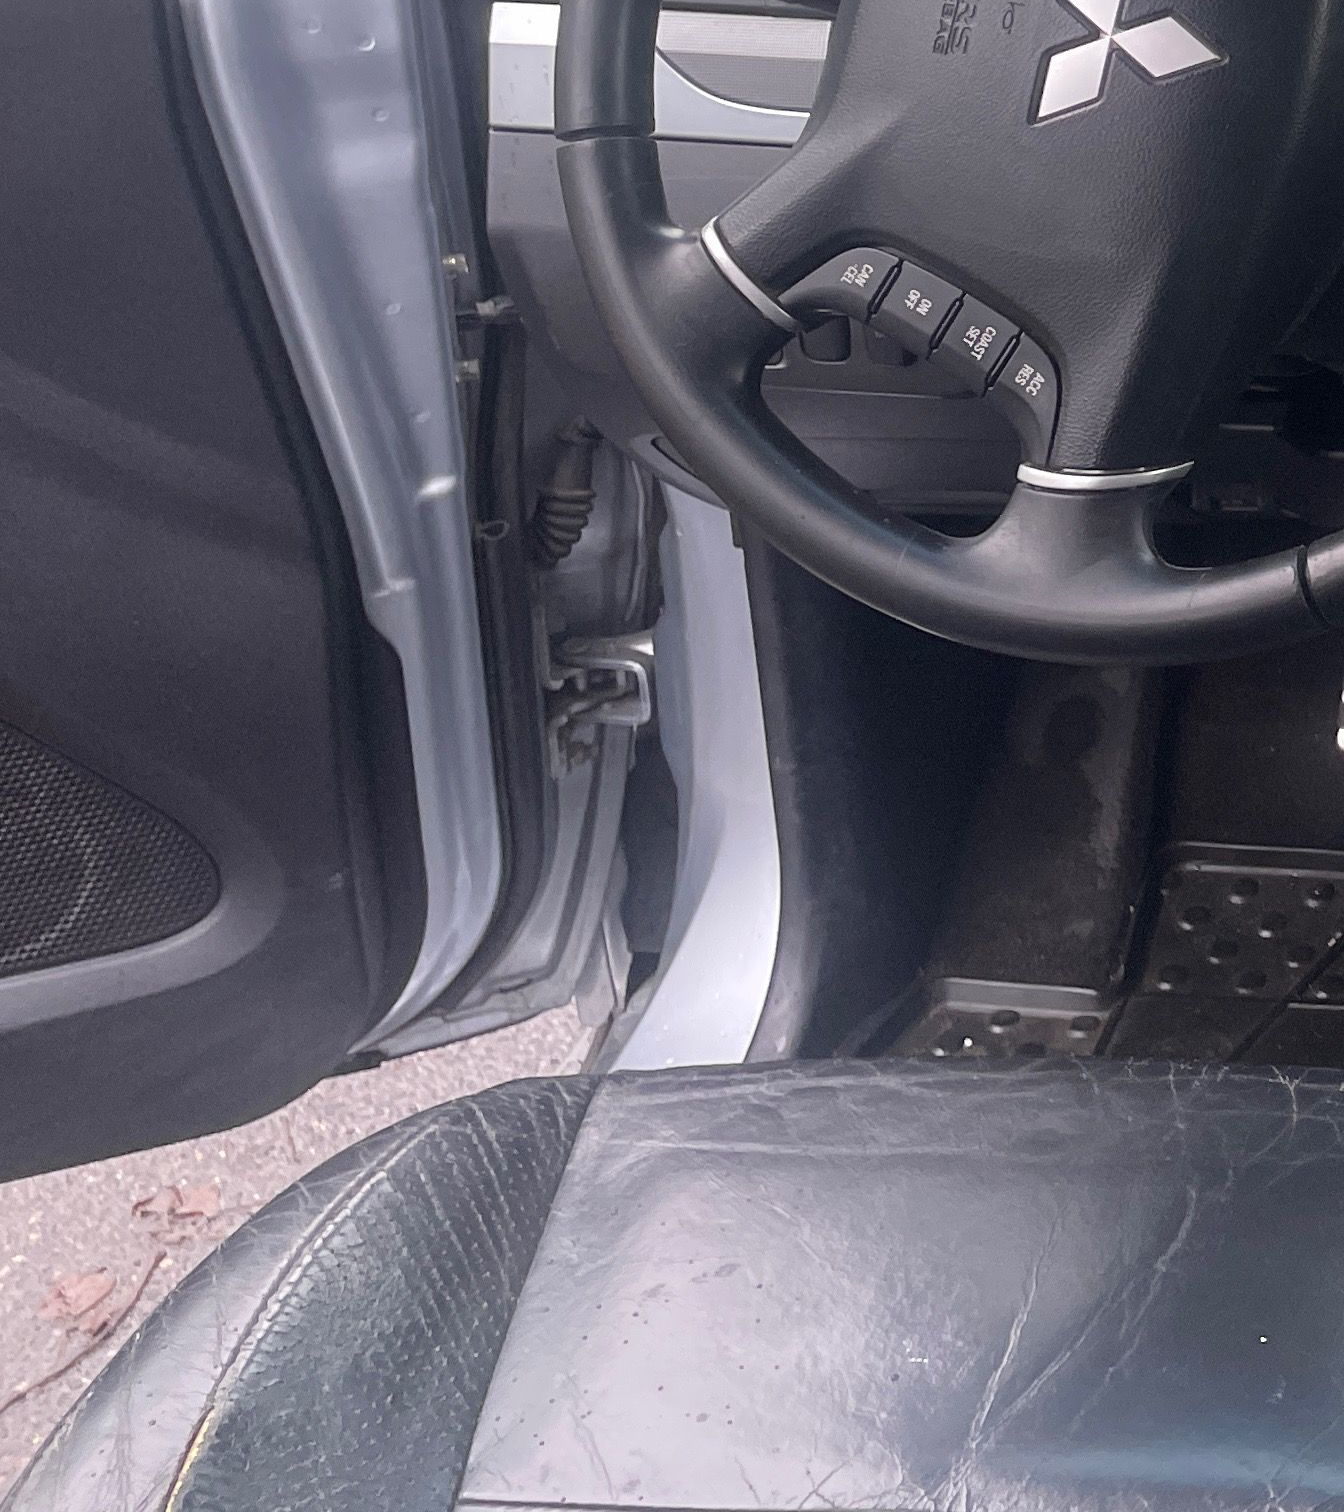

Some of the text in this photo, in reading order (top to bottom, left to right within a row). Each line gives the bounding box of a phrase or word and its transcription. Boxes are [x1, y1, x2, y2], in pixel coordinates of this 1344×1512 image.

[855, 263, 874, 288] CAN
[904, 289, 921, 310] OFF
[916, 298, 932, 316] ON
[963, 325, 981, 348] SET
[970, 326, 997, 361] COAST
[1014, 364, 1035, 386] RES
[1026, 372, 1045, 396] ACC
